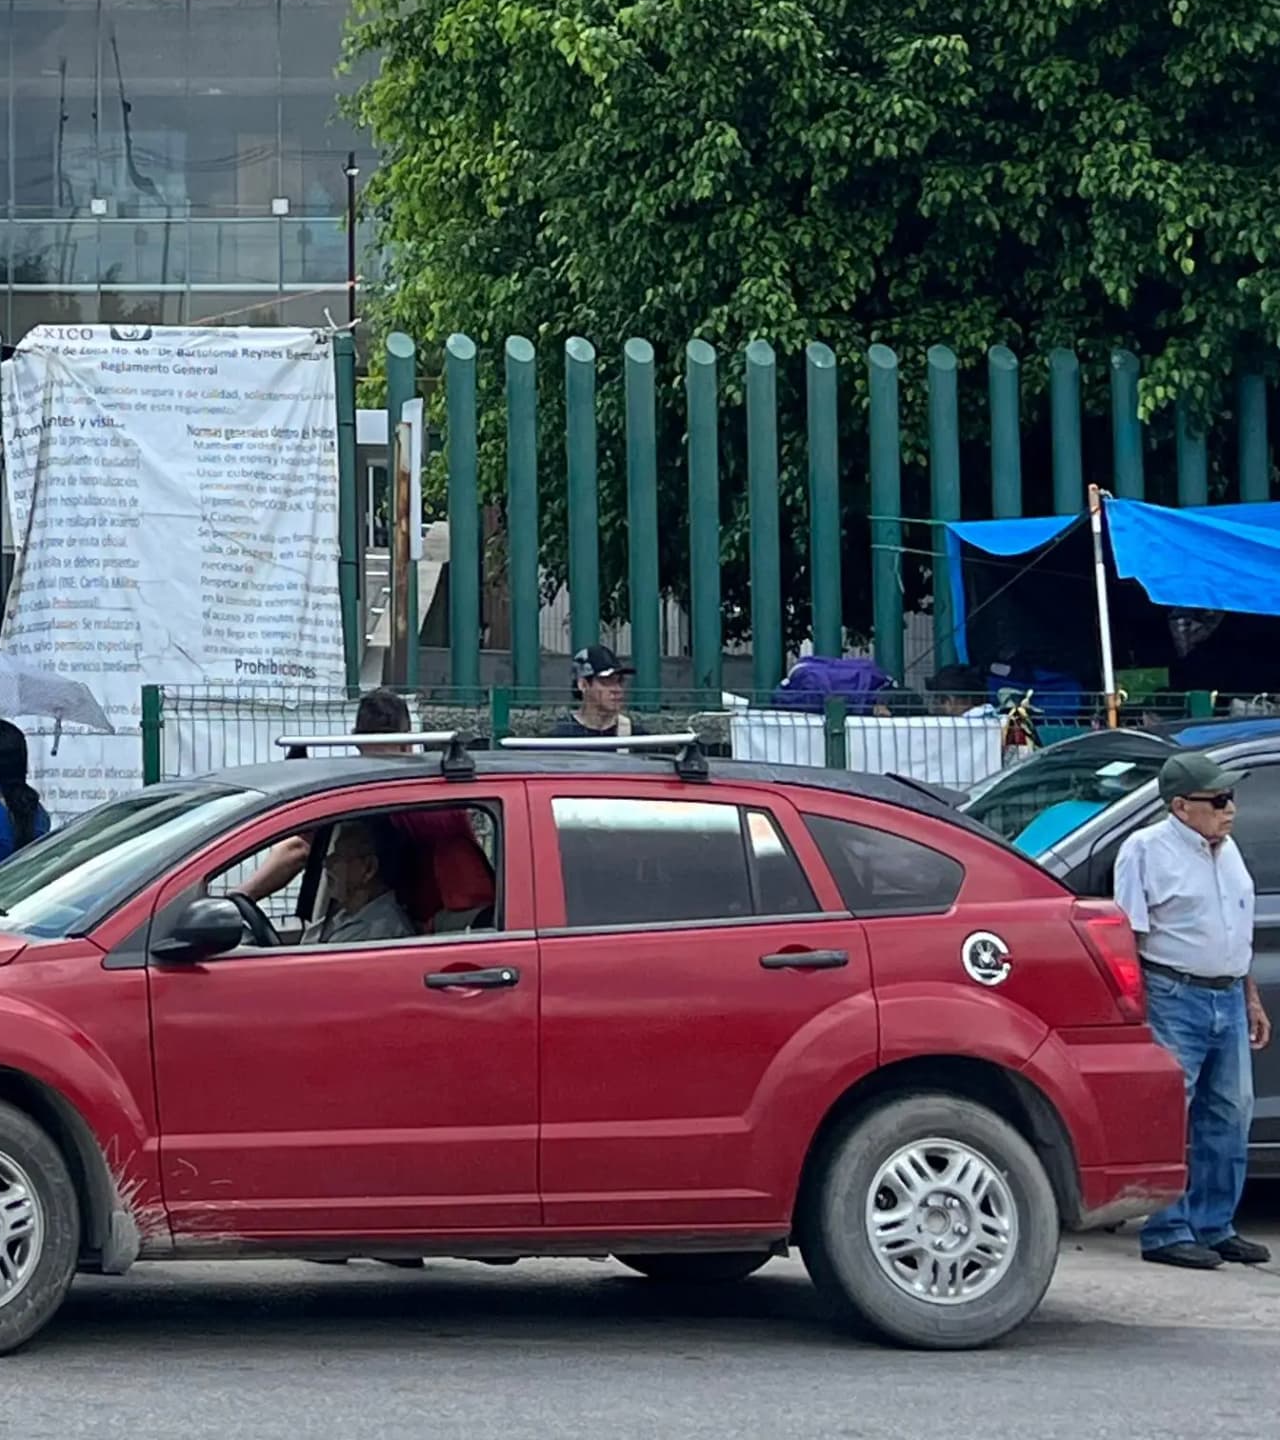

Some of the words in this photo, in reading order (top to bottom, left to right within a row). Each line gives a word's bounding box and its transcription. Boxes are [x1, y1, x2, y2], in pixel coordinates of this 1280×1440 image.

[100, 361, 169, 375] Reglamento
[172, 363, 218, 375] General
[234, 658, 317, 680] Prohibiciones
